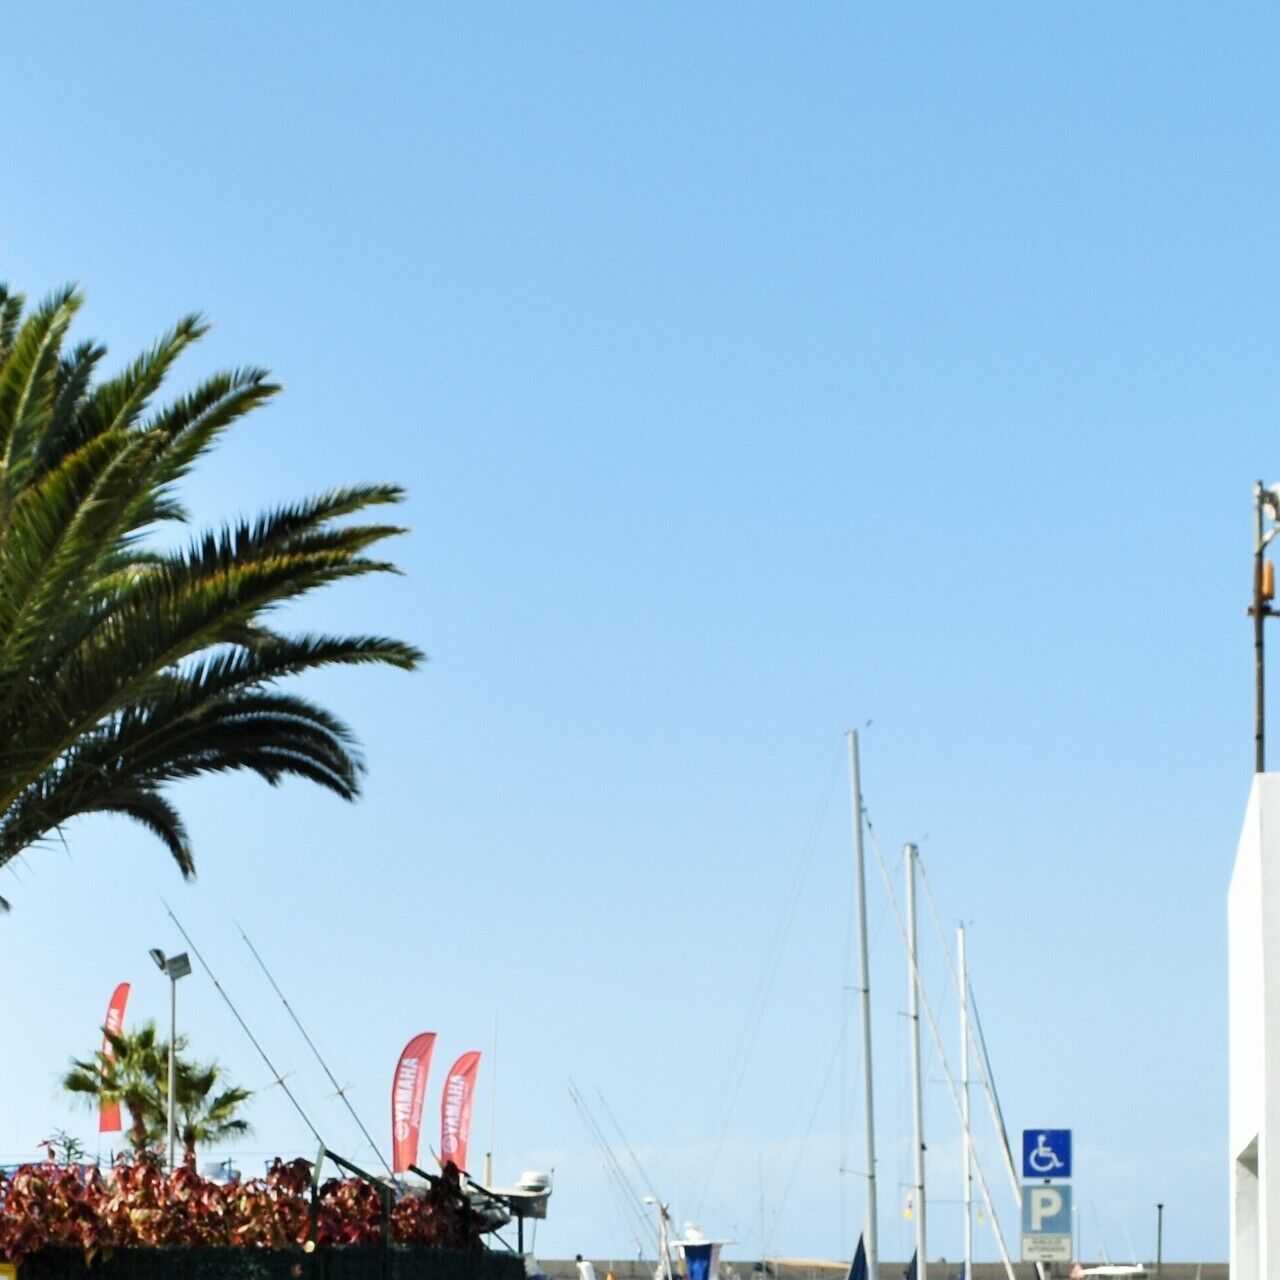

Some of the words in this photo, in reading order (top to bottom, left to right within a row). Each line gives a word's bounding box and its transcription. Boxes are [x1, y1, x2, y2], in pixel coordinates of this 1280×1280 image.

[395, 1057, 419, 1122] YAMAHA
[444, 1074, 466, 1135] YAMAHA
[1030, 1187, 1063, 1232] P
